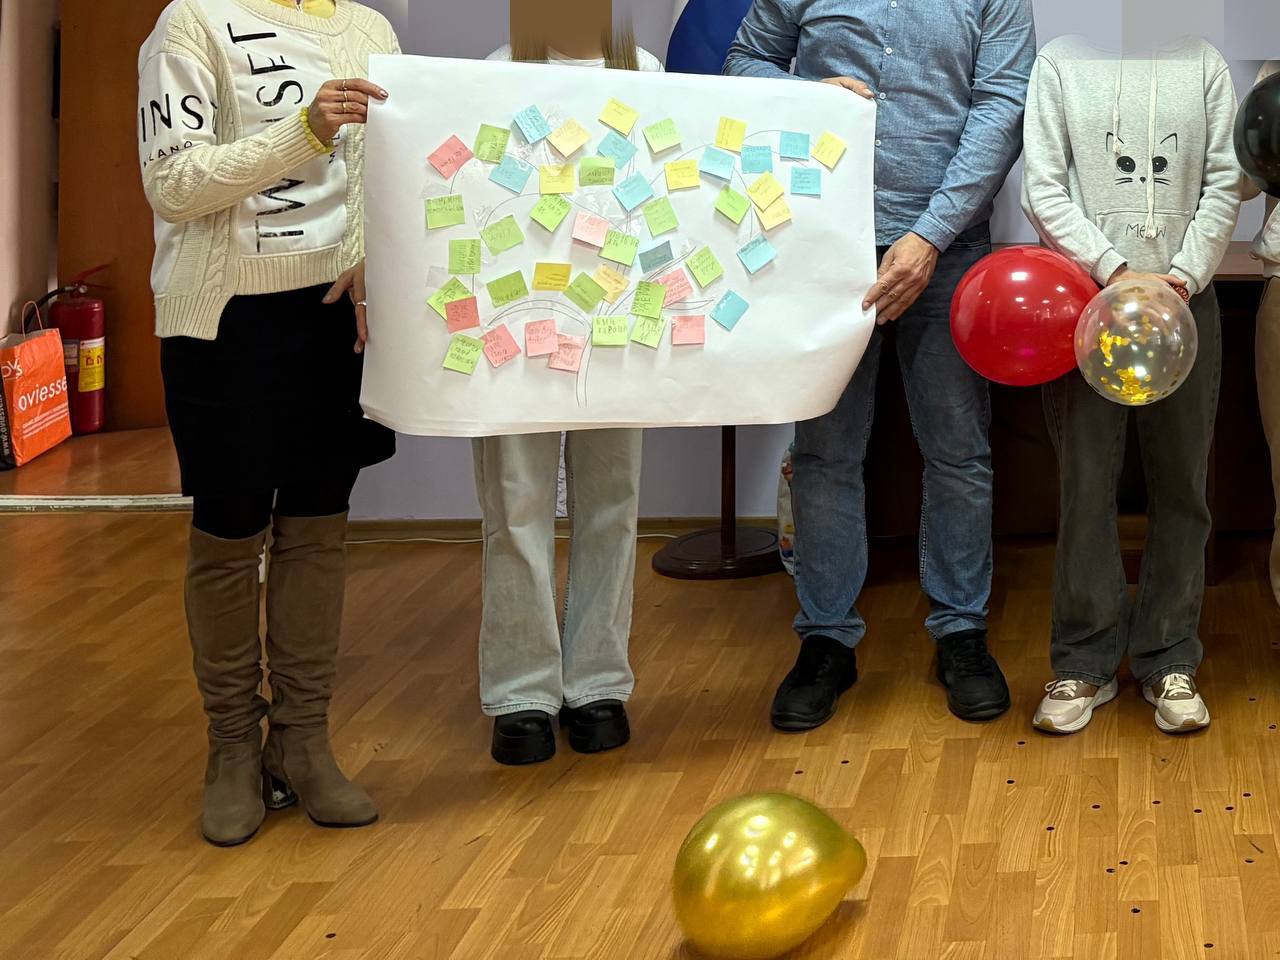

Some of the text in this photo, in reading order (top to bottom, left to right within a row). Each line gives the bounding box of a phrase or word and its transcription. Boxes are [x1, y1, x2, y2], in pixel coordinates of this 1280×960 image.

[227, 22, 306, 253] TWSET
[1125, 223, 1167, 240] Mew
[18, 375, 68, 412] oviesse
